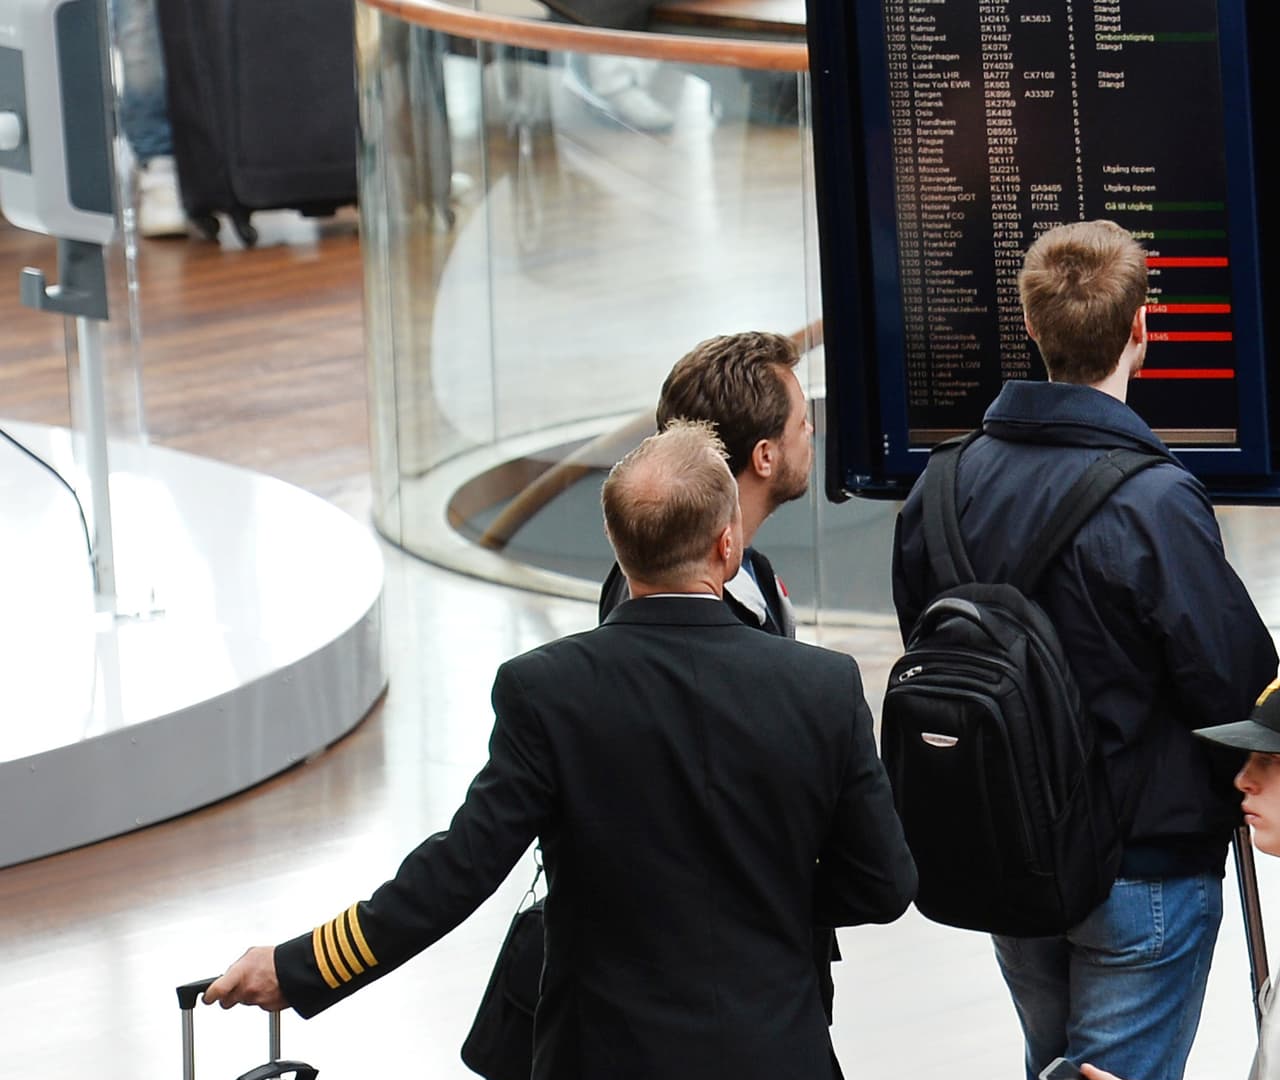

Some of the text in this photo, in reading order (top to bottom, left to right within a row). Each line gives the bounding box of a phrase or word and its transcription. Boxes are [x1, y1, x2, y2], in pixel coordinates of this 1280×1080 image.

[910, 35, 947, 43] Budapest
[911, 44, 933, 52] Visby
[943, 71, 960, 79] LHR
[915, 109, 934, 117] Oslo
